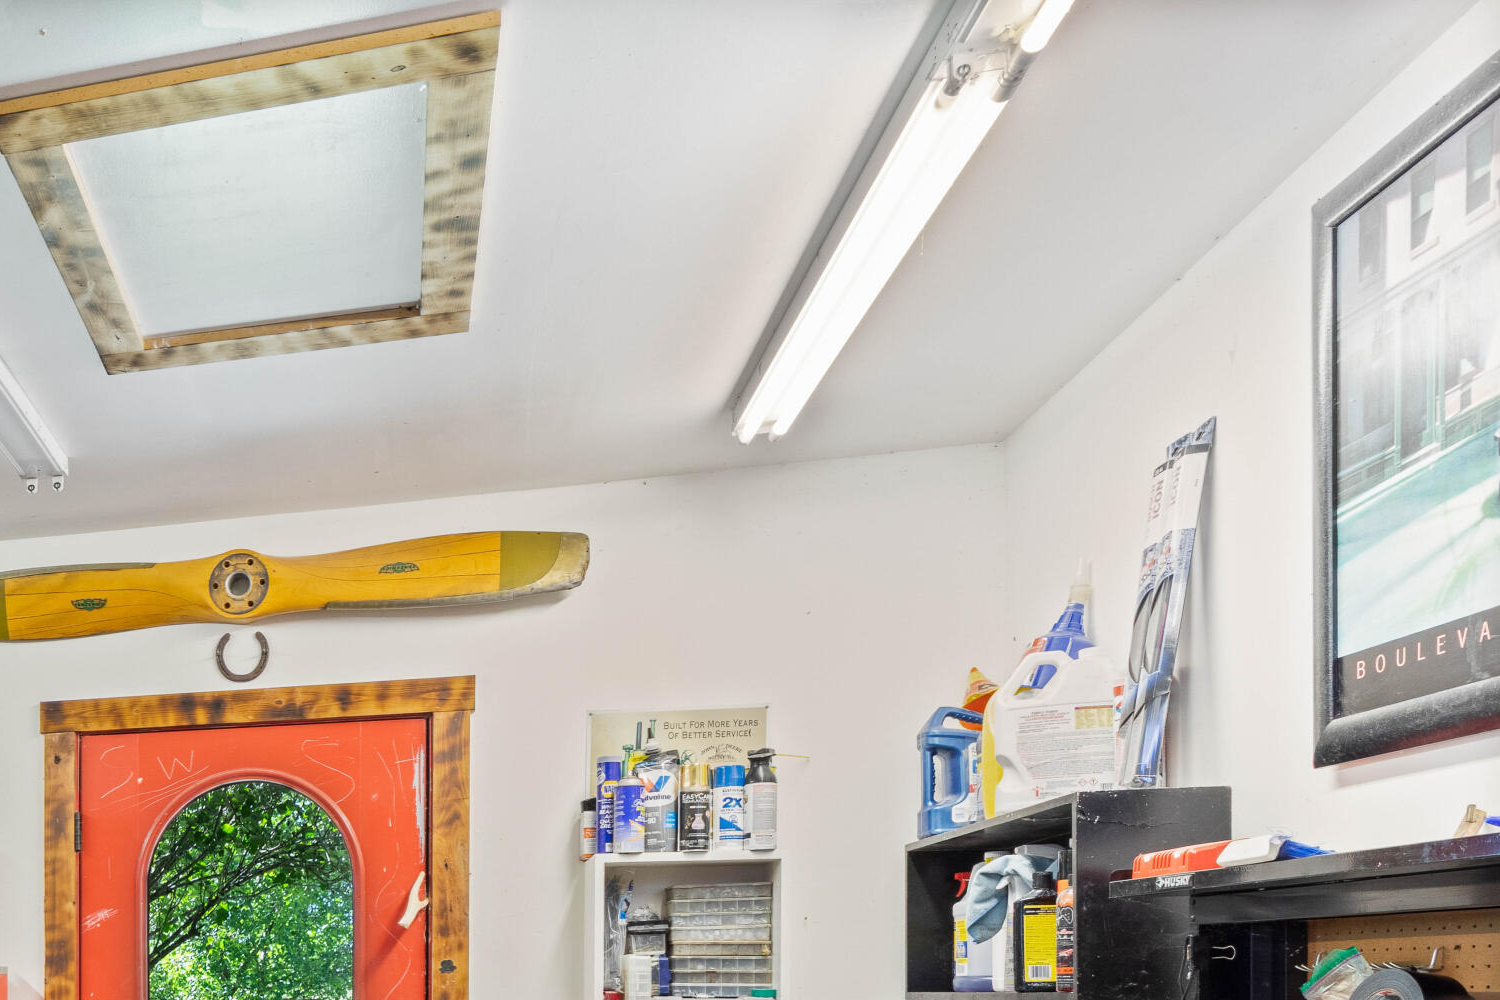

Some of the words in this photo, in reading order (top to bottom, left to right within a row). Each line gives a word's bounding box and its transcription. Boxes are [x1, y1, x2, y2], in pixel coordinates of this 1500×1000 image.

[1356, 620, 1492, 679] BOULEVA
[663, 721, 687, 730] BUILT
[689, 720, 705, 729] FOR
[707, 719, 731, 728] MORE
[733, 719, 759, 727] YEARS
[667, 731, 679, 739] OF
[681, 730, 713, 739] BETTER
[722, 796, 743, 809] 2X
[1164, 875, 1190, 888] HUSKY
